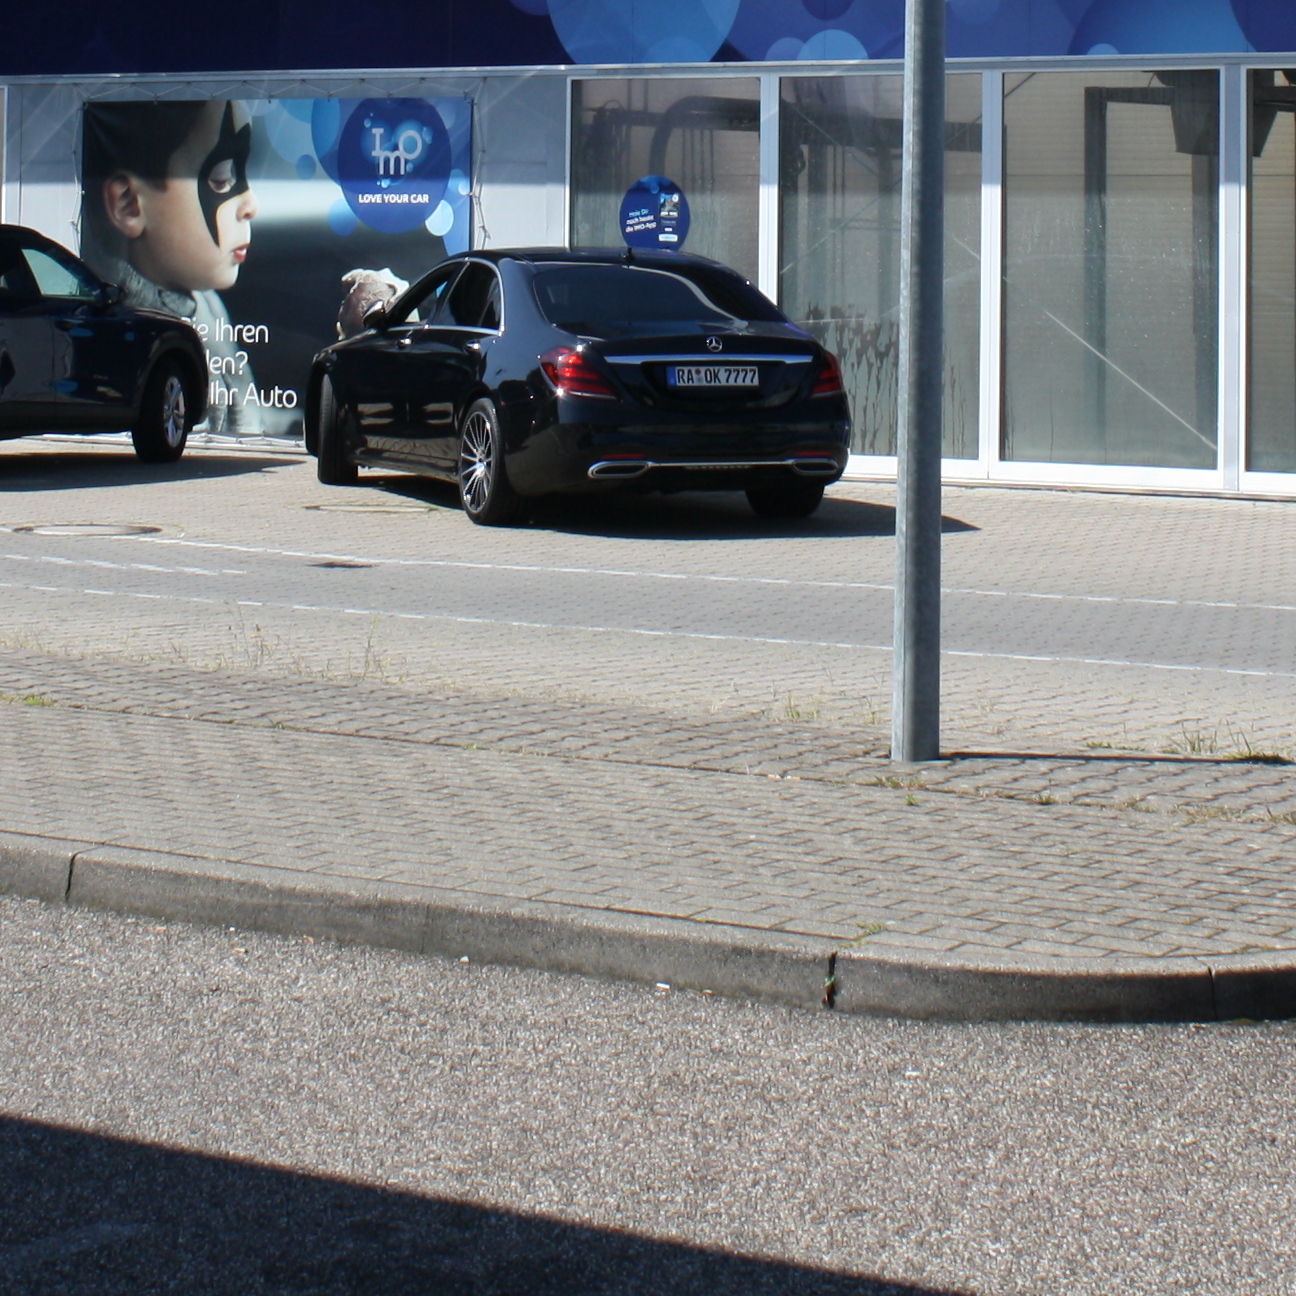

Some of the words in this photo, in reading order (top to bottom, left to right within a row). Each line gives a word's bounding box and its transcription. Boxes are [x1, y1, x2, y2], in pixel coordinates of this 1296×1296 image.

[358, 193, 383, 204] LOVE
[384, 193, 410, 204] YOUR
[410, 193, 430, 204] CAR
[215, 317, 269, 344] Ihren
[676, 368, 695, 384] RA
[724, 368, 757, 384] 7777
[209, 379, 239, 406] Ihr
[243, 382, 298, 409] Auto
